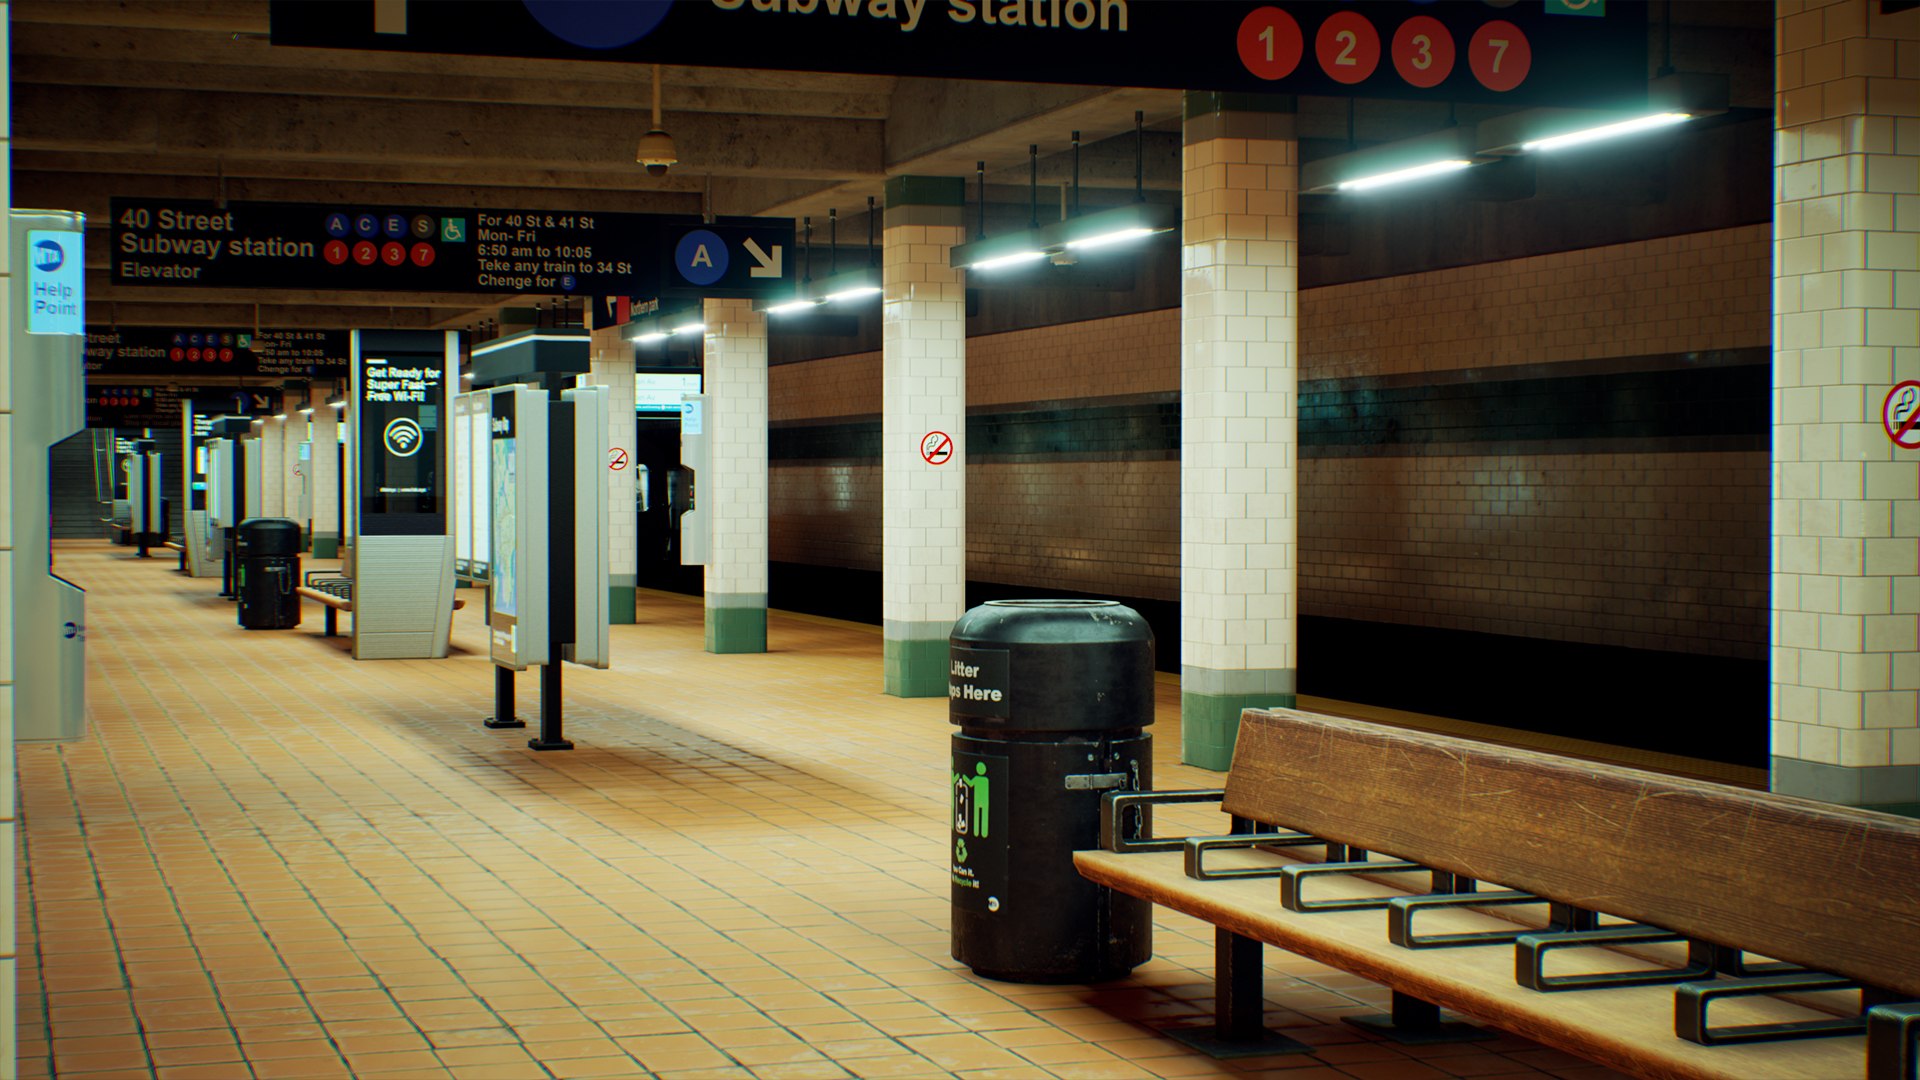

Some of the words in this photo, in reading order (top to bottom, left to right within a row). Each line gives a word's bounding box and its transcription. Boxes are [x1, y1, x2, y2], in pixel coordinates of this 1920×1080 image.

[712, 0, 926, 32] way
[947, 0, 1129, 32] station
[1257, 25, 1274, 61] 1
[1335, 31, 1357, 66] 2
[1411, 35, 1433, 70] 3
[1488, 39, 1509, 73] 7
[120, 208, 150, 229] 40
[157, 209, 234, 231] Street
[331, 217, 343, 231] A
[359, 218, 371, 231] C
[388, 219, 399, 232] E
[417, 219, 428, 232] S
[478, 213, 502, 226] For
[505, 215, 522, 227] 40
[526, 215, 541, 228] St
[544, 215, 555, 228] &
[558, 216, 575, 229] 41
[579, 216, 595, 229] St
[478, 229, 514, 241] Mon-
[517, 230, 536, 242] Fri
[120, 232, 222, 260] Subway
[228, 236, 315, 257] station
[333, 246, 340, 259] 1
[361, 247, 371, 260] 2
[390, 248, 399, 261] 3
[419, 249, 428, 261] 7
[478, 244, 507, 256] 6:50
[511, 247, 532, 257] am
[536, 245, 551, 257] to
[555, 246, 592, 258] 10:05
[691, 244, 713, 267] A
[121, 261, 201, 278] Elevator
[514, 261, 540, 275] any
[543, 260, 575, 273] train
[579, 261, 593, 273] to
[597, 262, 613, 274] 34
[617, 262, 632, 274] St
[535, 274, 556, 287] for
[563, 277, 571, 286] E
[33, 282, 72, 300] Help
[34, 300, 76, 315] Point
[117, 346, 166, 358] station
[366, 366, 387, 378] Get
[388, 367, 424, 380] Ready
[424, 367, 442, 379] for
[366, 378, 400, 391] Super
[401, 379, 427, 390] Fast
[366, 390, 392, 402] Free
[950, 659, 980, 678] Litter
[963, 684, 1003, 702] Here
